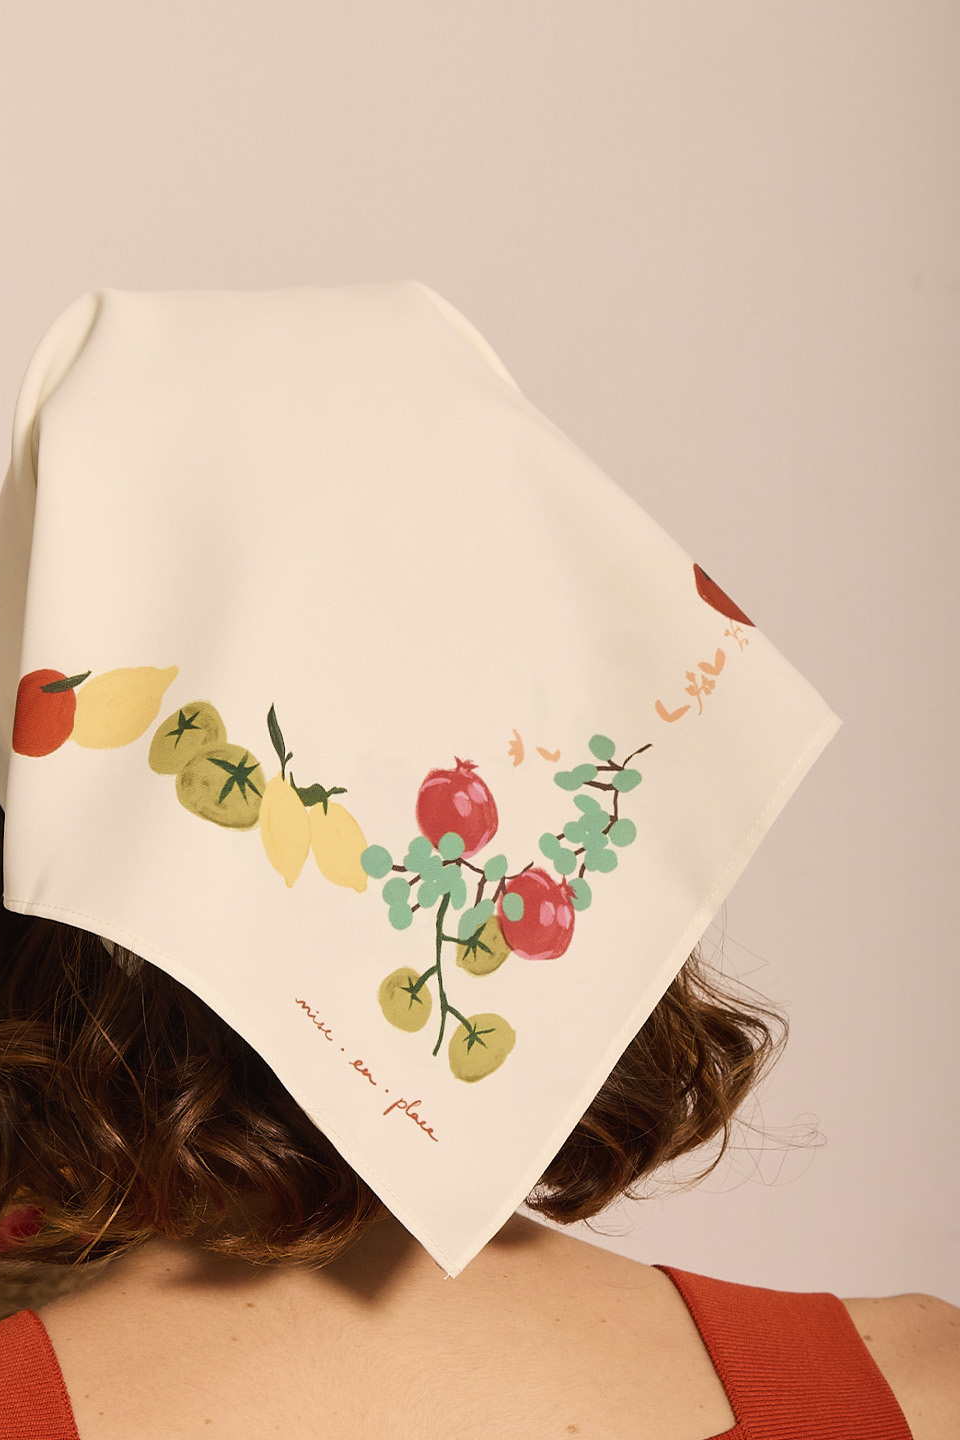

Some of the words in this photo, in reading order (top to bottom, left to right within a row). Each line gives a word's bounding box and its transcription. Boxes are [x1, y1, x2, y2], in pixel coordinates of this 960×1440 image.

[295, 998, 333, 1042] mise
[348, 1059, 377, 1086] en
[383, 1097, 439, 1143] place
